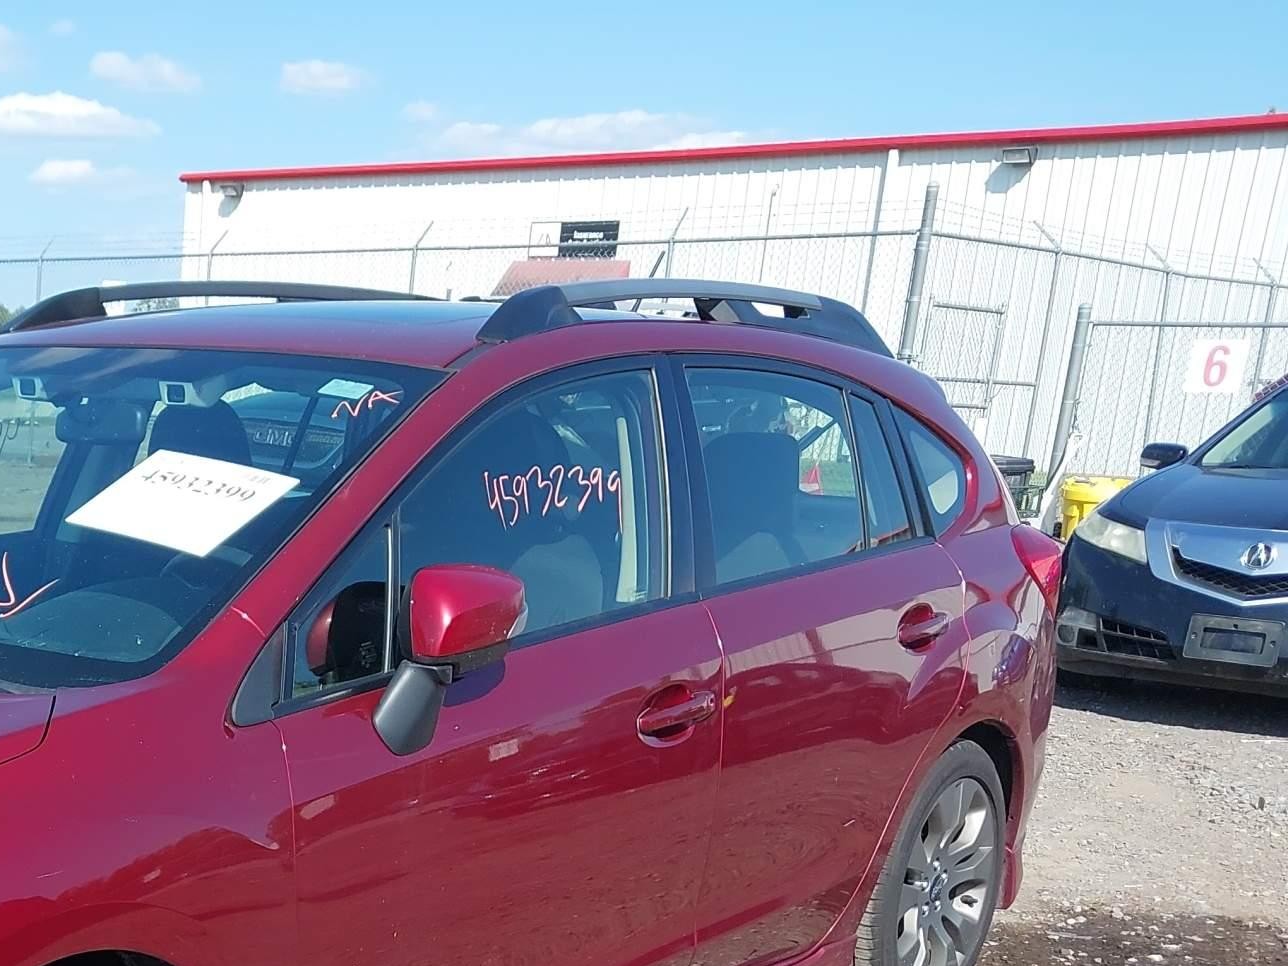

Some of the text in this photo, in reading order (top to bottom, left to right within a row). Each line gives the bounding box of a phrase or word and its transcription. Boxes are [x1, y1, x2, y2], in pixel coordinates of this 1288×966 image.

[1203, 345, 1231, 387] 6
[141, 468, 257, 503] 45932399
[483, 464, 623, 534] 45932399
